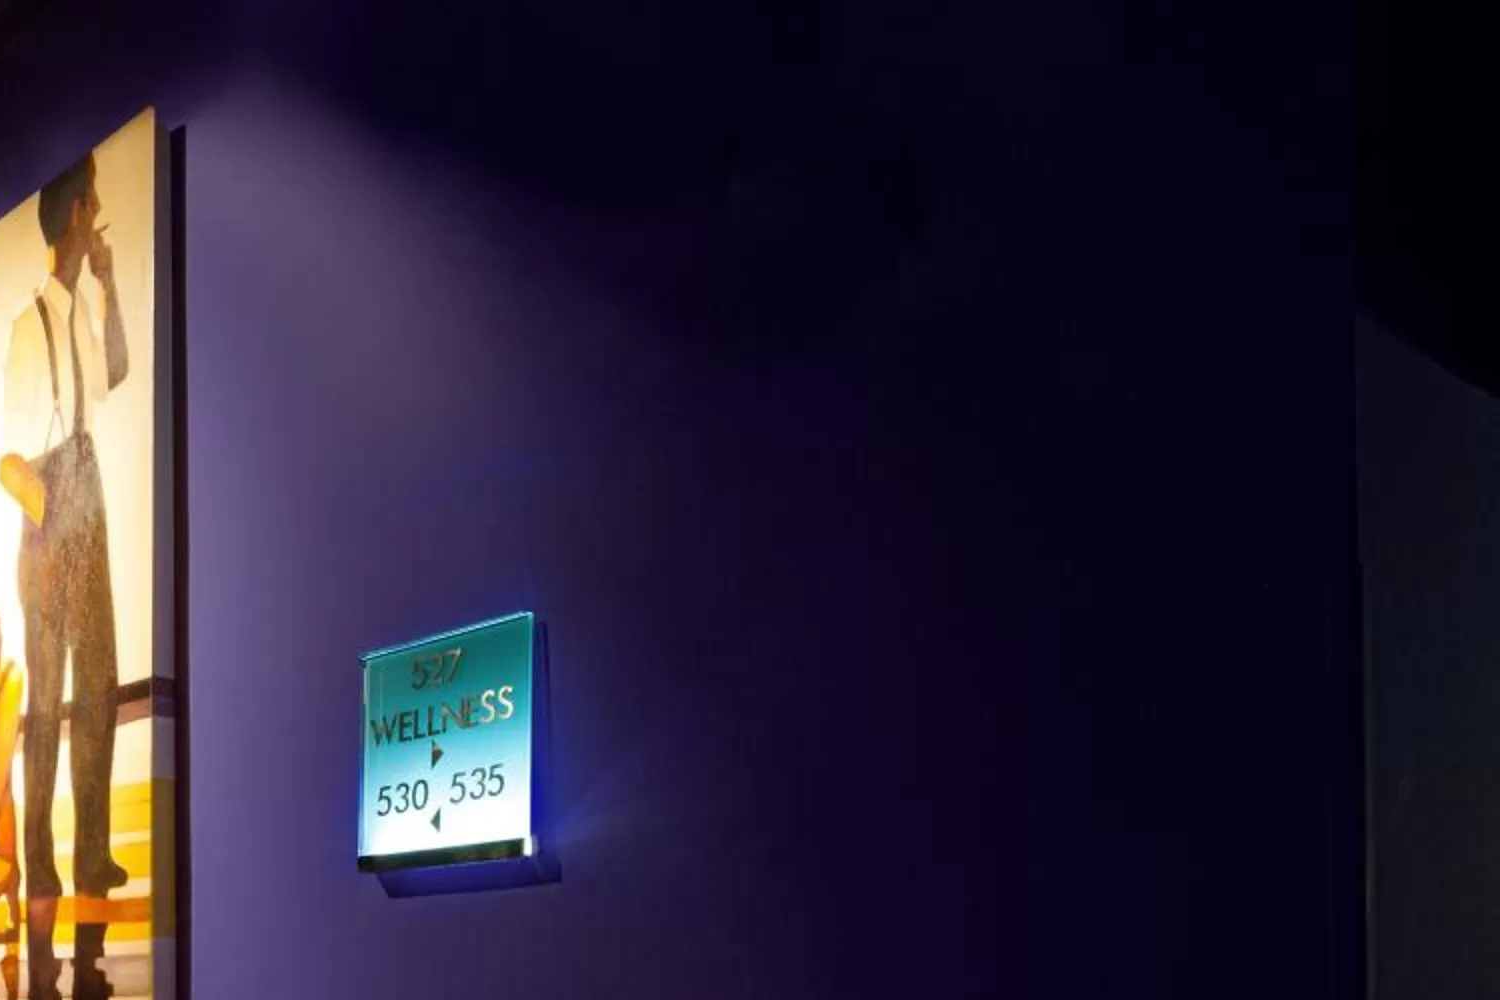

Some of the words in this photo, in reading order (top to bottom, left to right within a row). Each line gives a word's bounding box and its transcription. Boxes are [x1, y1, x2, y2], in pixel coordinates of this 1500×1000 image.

[370, 685, 514, 747] WELLNESS
[376, 779, 429, 817] 530
[449, 763, 505, 804] 535
